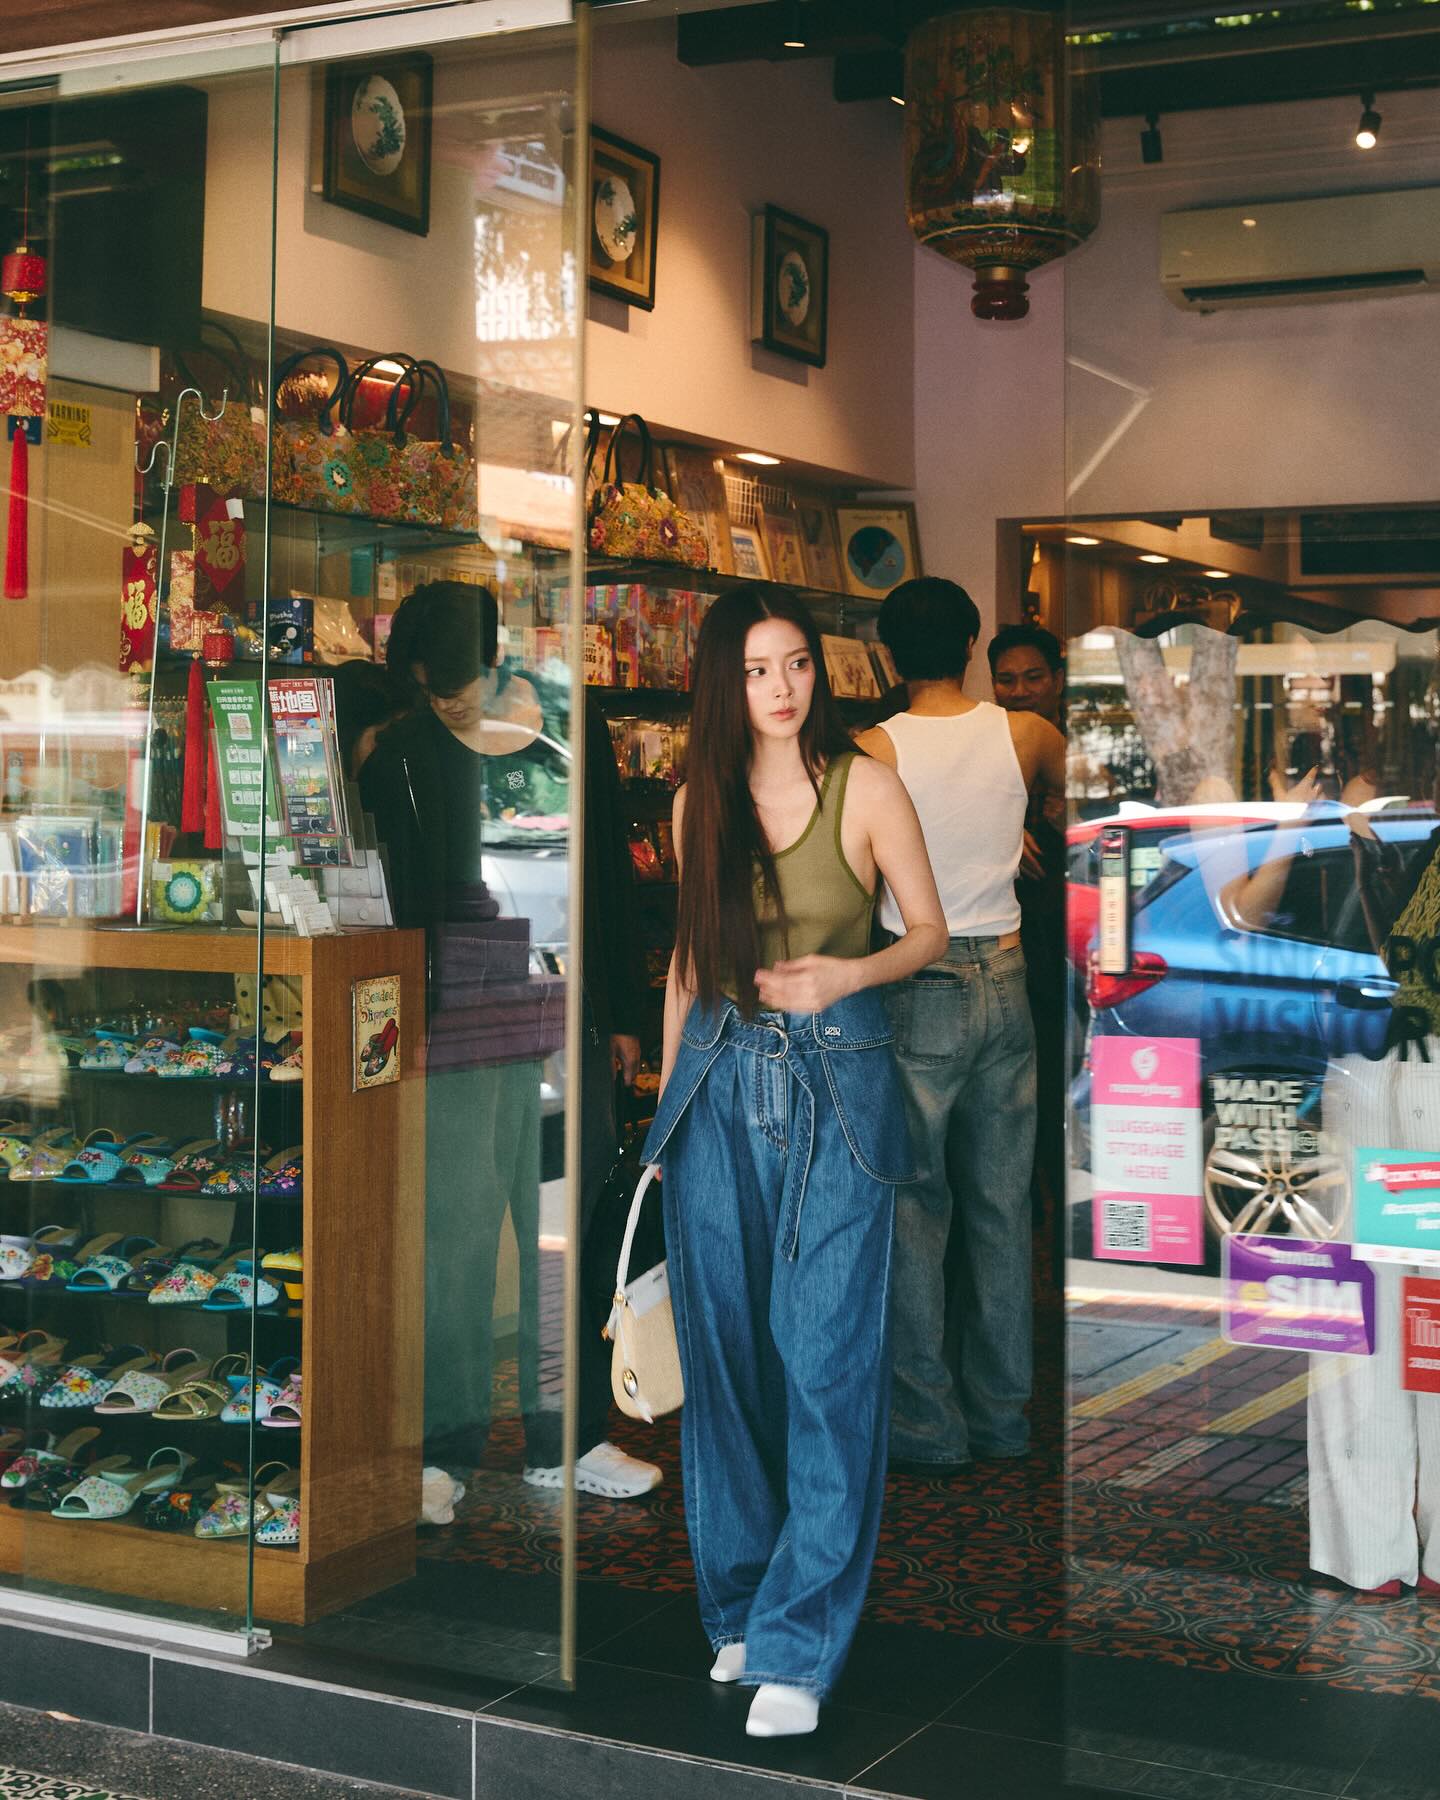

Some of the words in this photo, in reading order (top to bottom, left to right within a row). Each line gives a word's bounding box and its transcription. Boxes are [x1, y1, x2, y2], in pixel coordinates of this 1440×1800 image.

[204, 521, 240, 570] 福
[124, 579, 148, 630] 福
[279, 690, 318, 713] 地图
[363, 988, 395, 1006] Beaded
[360, 1006, 398, 1025] Slippers
[1212, 1079, 1304, 1103] MADE
[1215, 1103, 1298, 1127] WITH
[1105, 1119, 1187, 1137] LUGGAGE
[1106, 1141, 1187, 1159] STORAGE
[1124, 1164, 1171, 1180] HERE
[1238, 1275, 1364, 1318] eSIM
